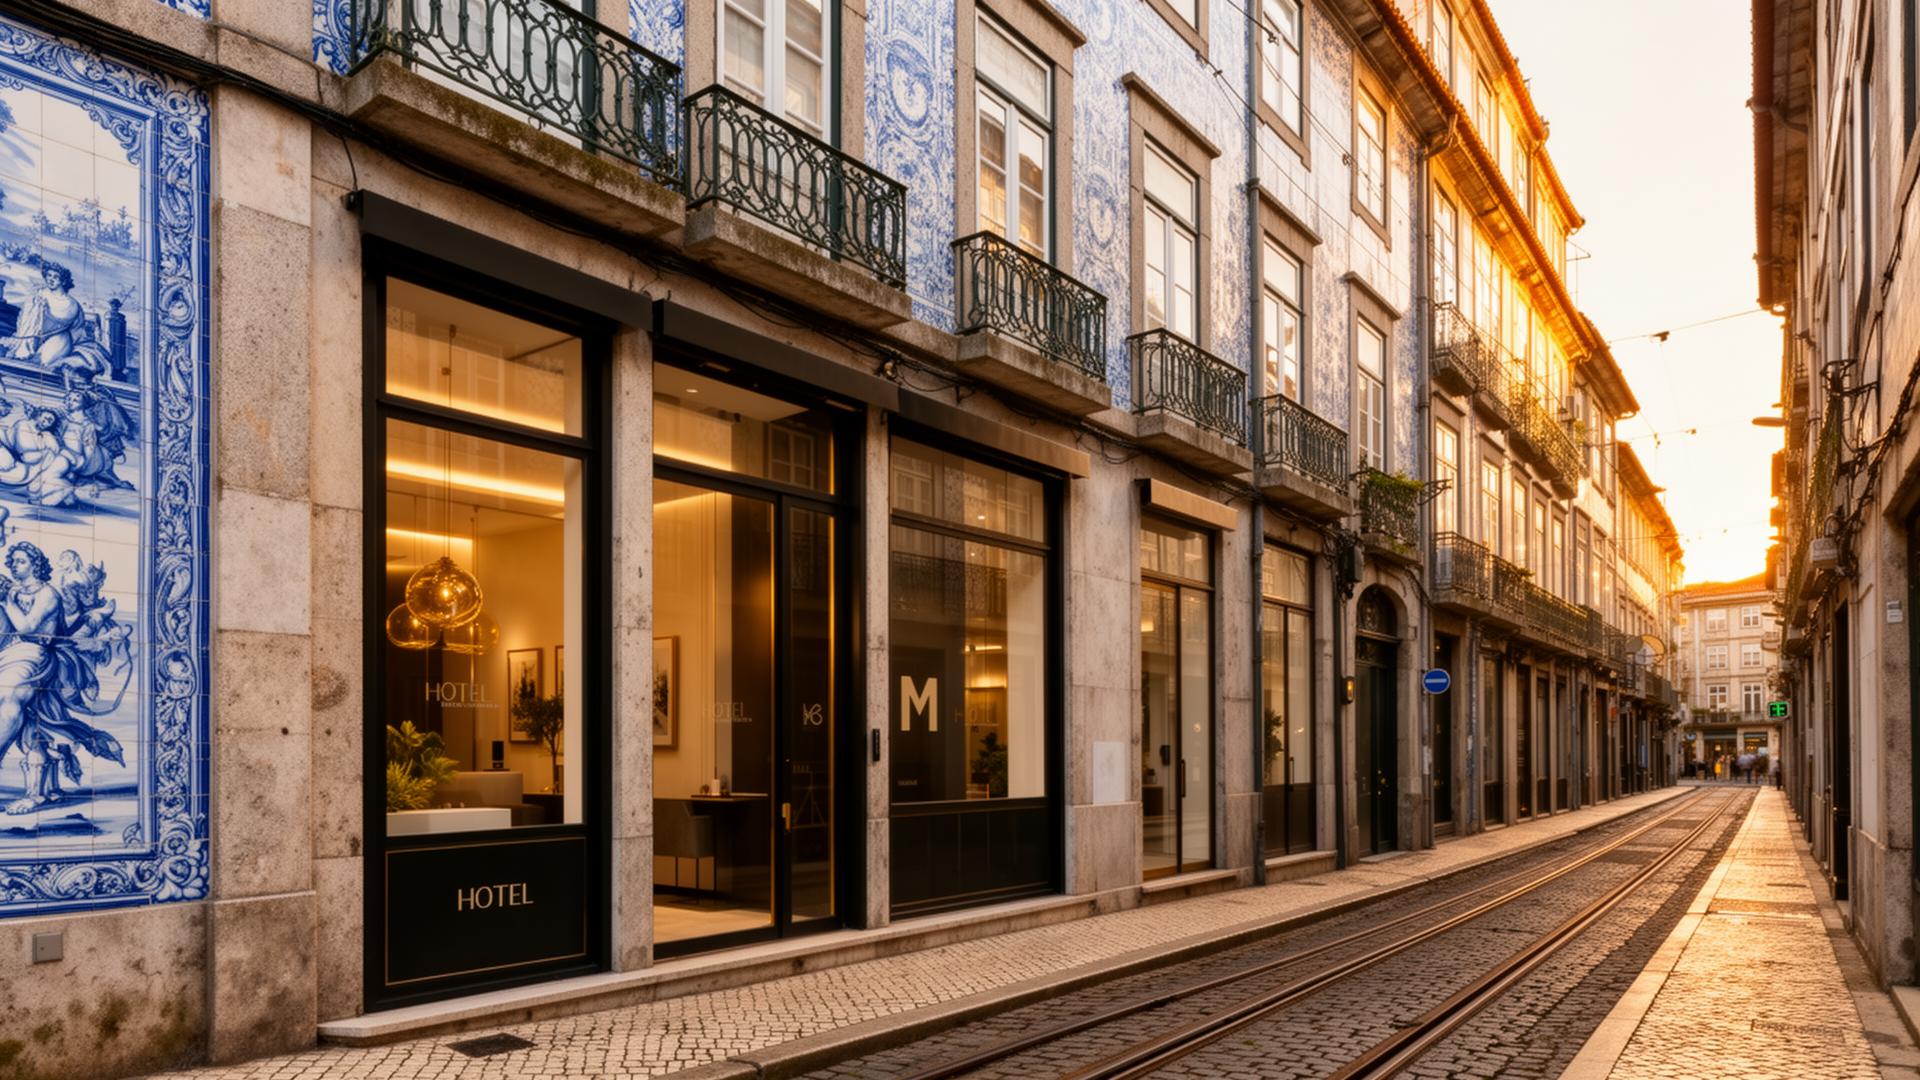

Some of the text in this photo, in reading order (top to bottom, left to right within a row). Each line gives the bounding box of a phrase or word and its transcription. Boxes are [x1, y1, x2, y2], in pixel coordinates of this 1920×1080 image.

[425, 681, 495, 702] HOTEL
[901, 675, 938, 732] M
[458, 882, 534, 911] HOTEL
